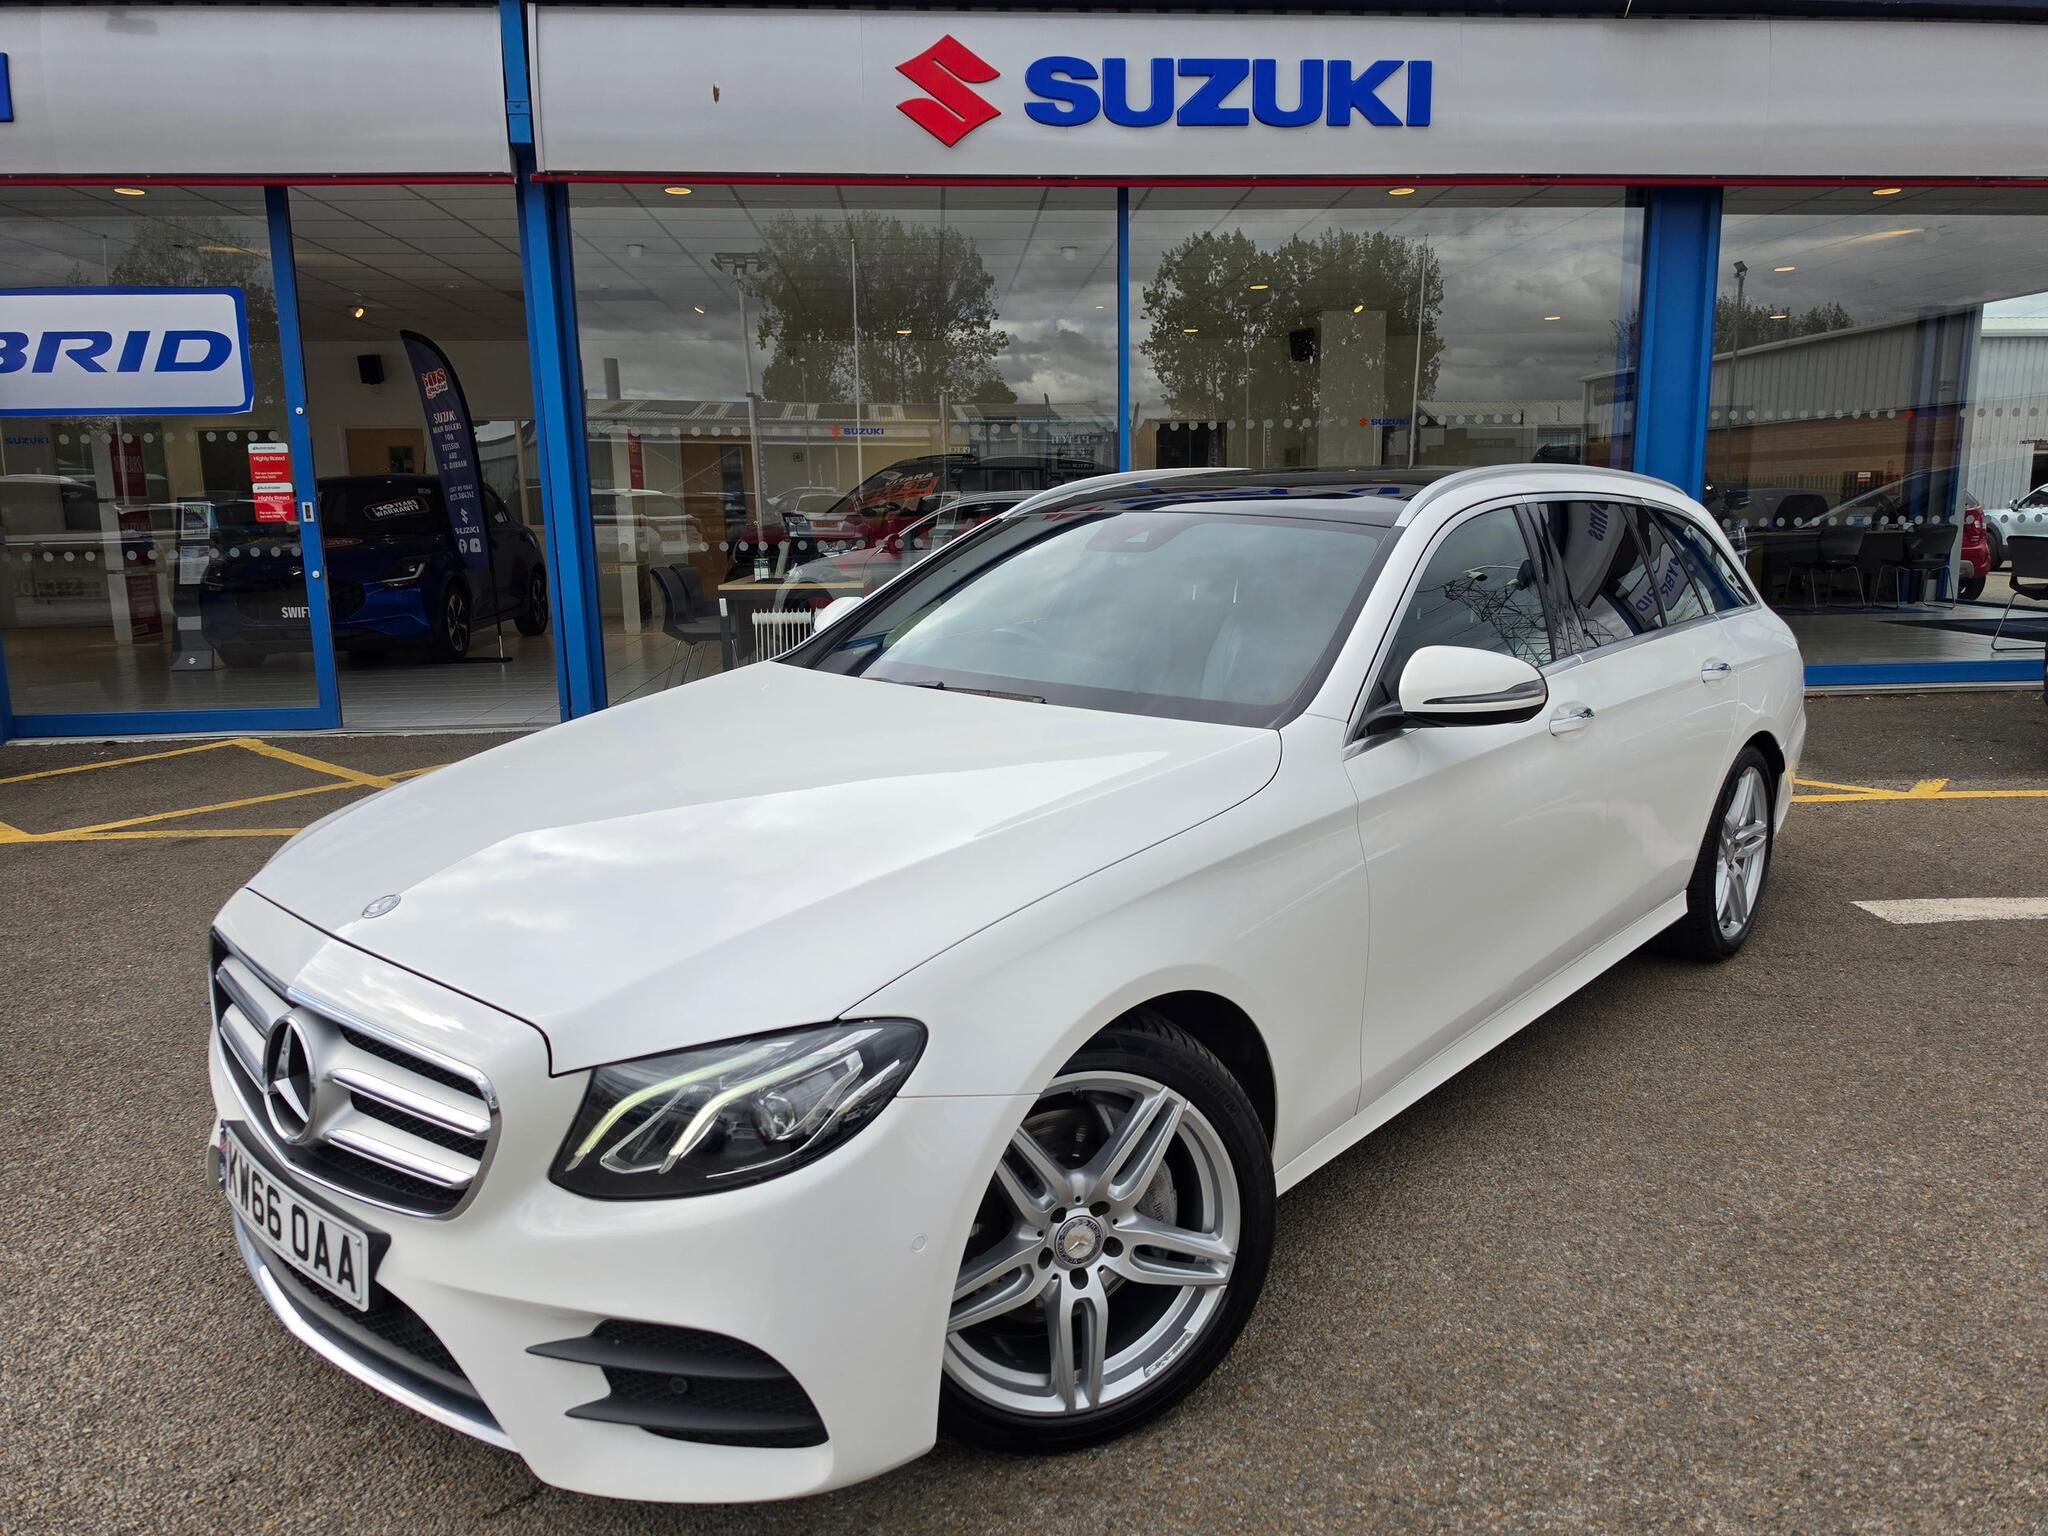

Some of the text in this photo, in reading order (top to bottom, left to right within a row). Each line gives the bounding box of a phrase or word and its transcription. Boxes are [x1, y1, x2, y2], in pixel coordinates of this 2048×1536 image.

[1024, 55, 1433, 128] SUZUKI
[1370, 418, 1409, 426] SUZUKI
[843, 427, 884, 435] SUZUKI
[5, 436, 49, 445] SUZUKI
[374, 504, 419, 517] WARRANTY
[291, 1203, 357, 1294] OAA
